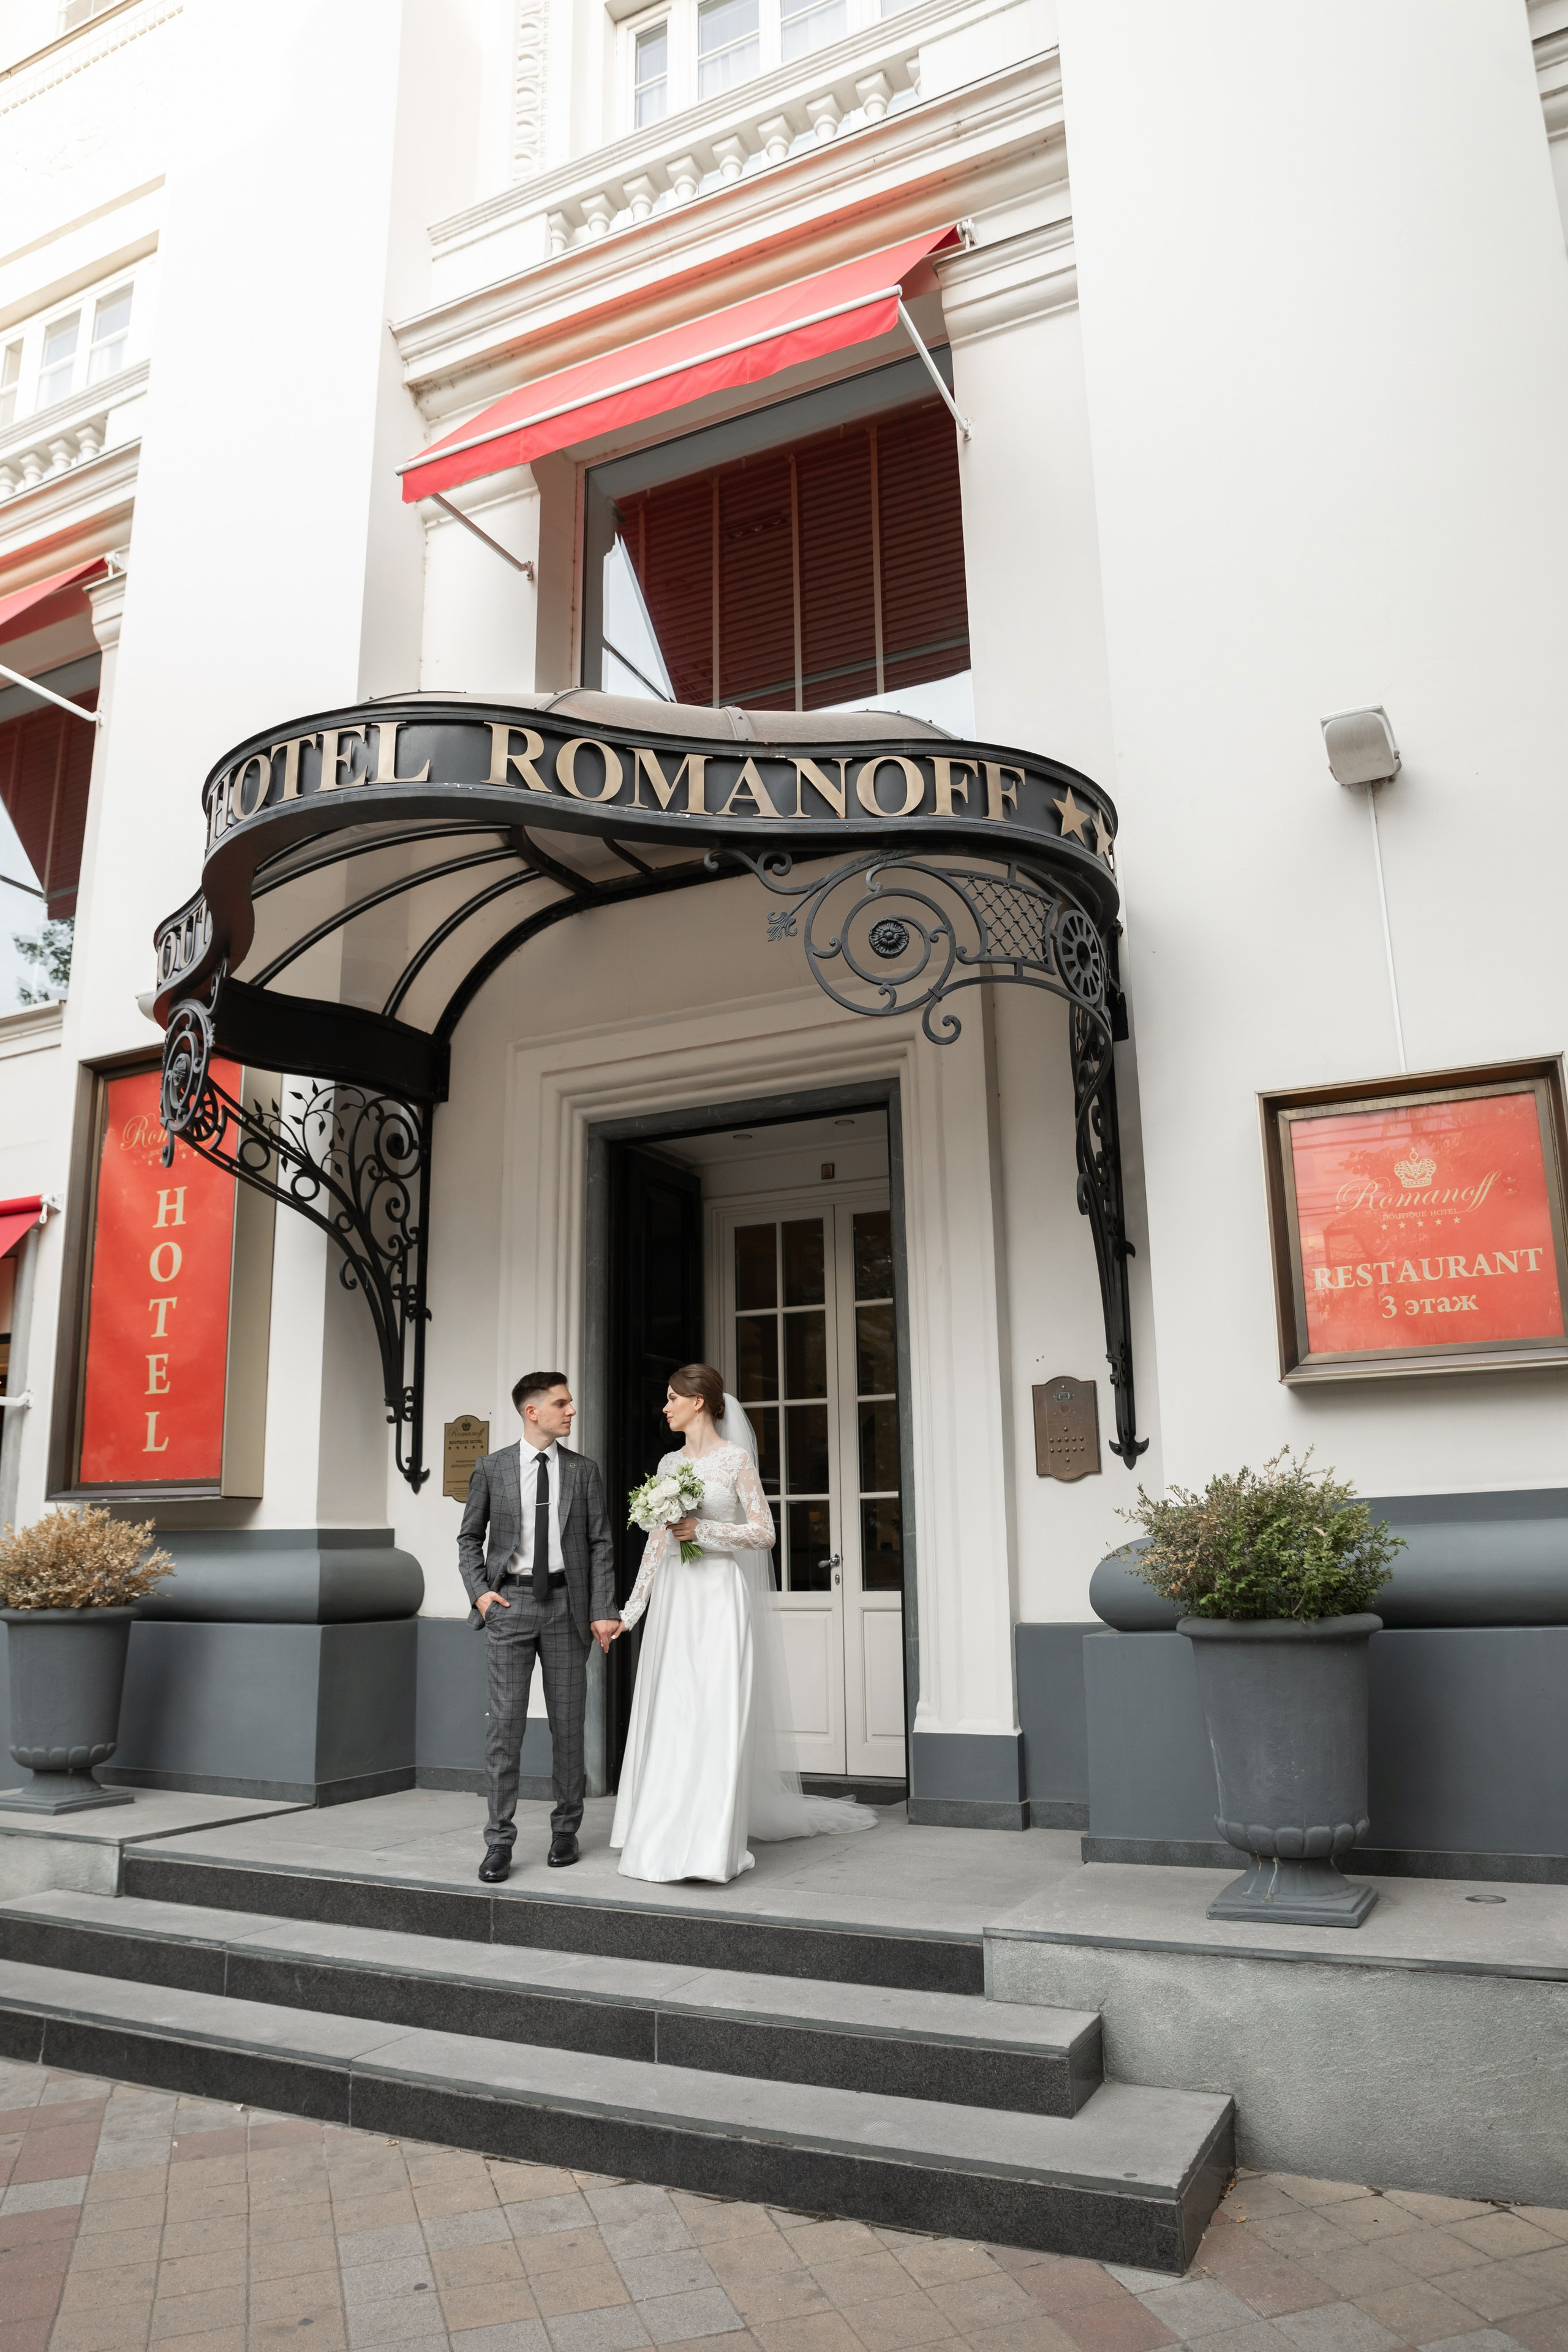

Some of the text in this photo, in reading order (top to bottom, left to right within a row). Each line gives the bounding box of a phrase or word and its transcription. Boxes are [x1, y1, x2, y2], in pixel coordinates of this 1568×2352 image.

[207, 721, 1026, 850] HOTEL ROMANOFF
[1335, 1170, 1501, 1213] Romanoff
[1382, 1208, 1459, 1221] BOUTIQUE HOTEL
[1311, 1248, 1544, 1291] RESTAURANT
[142, 1186, 187, 1453] HOTEL
[1381, 1294, 1479, 1319] 3 этаж
